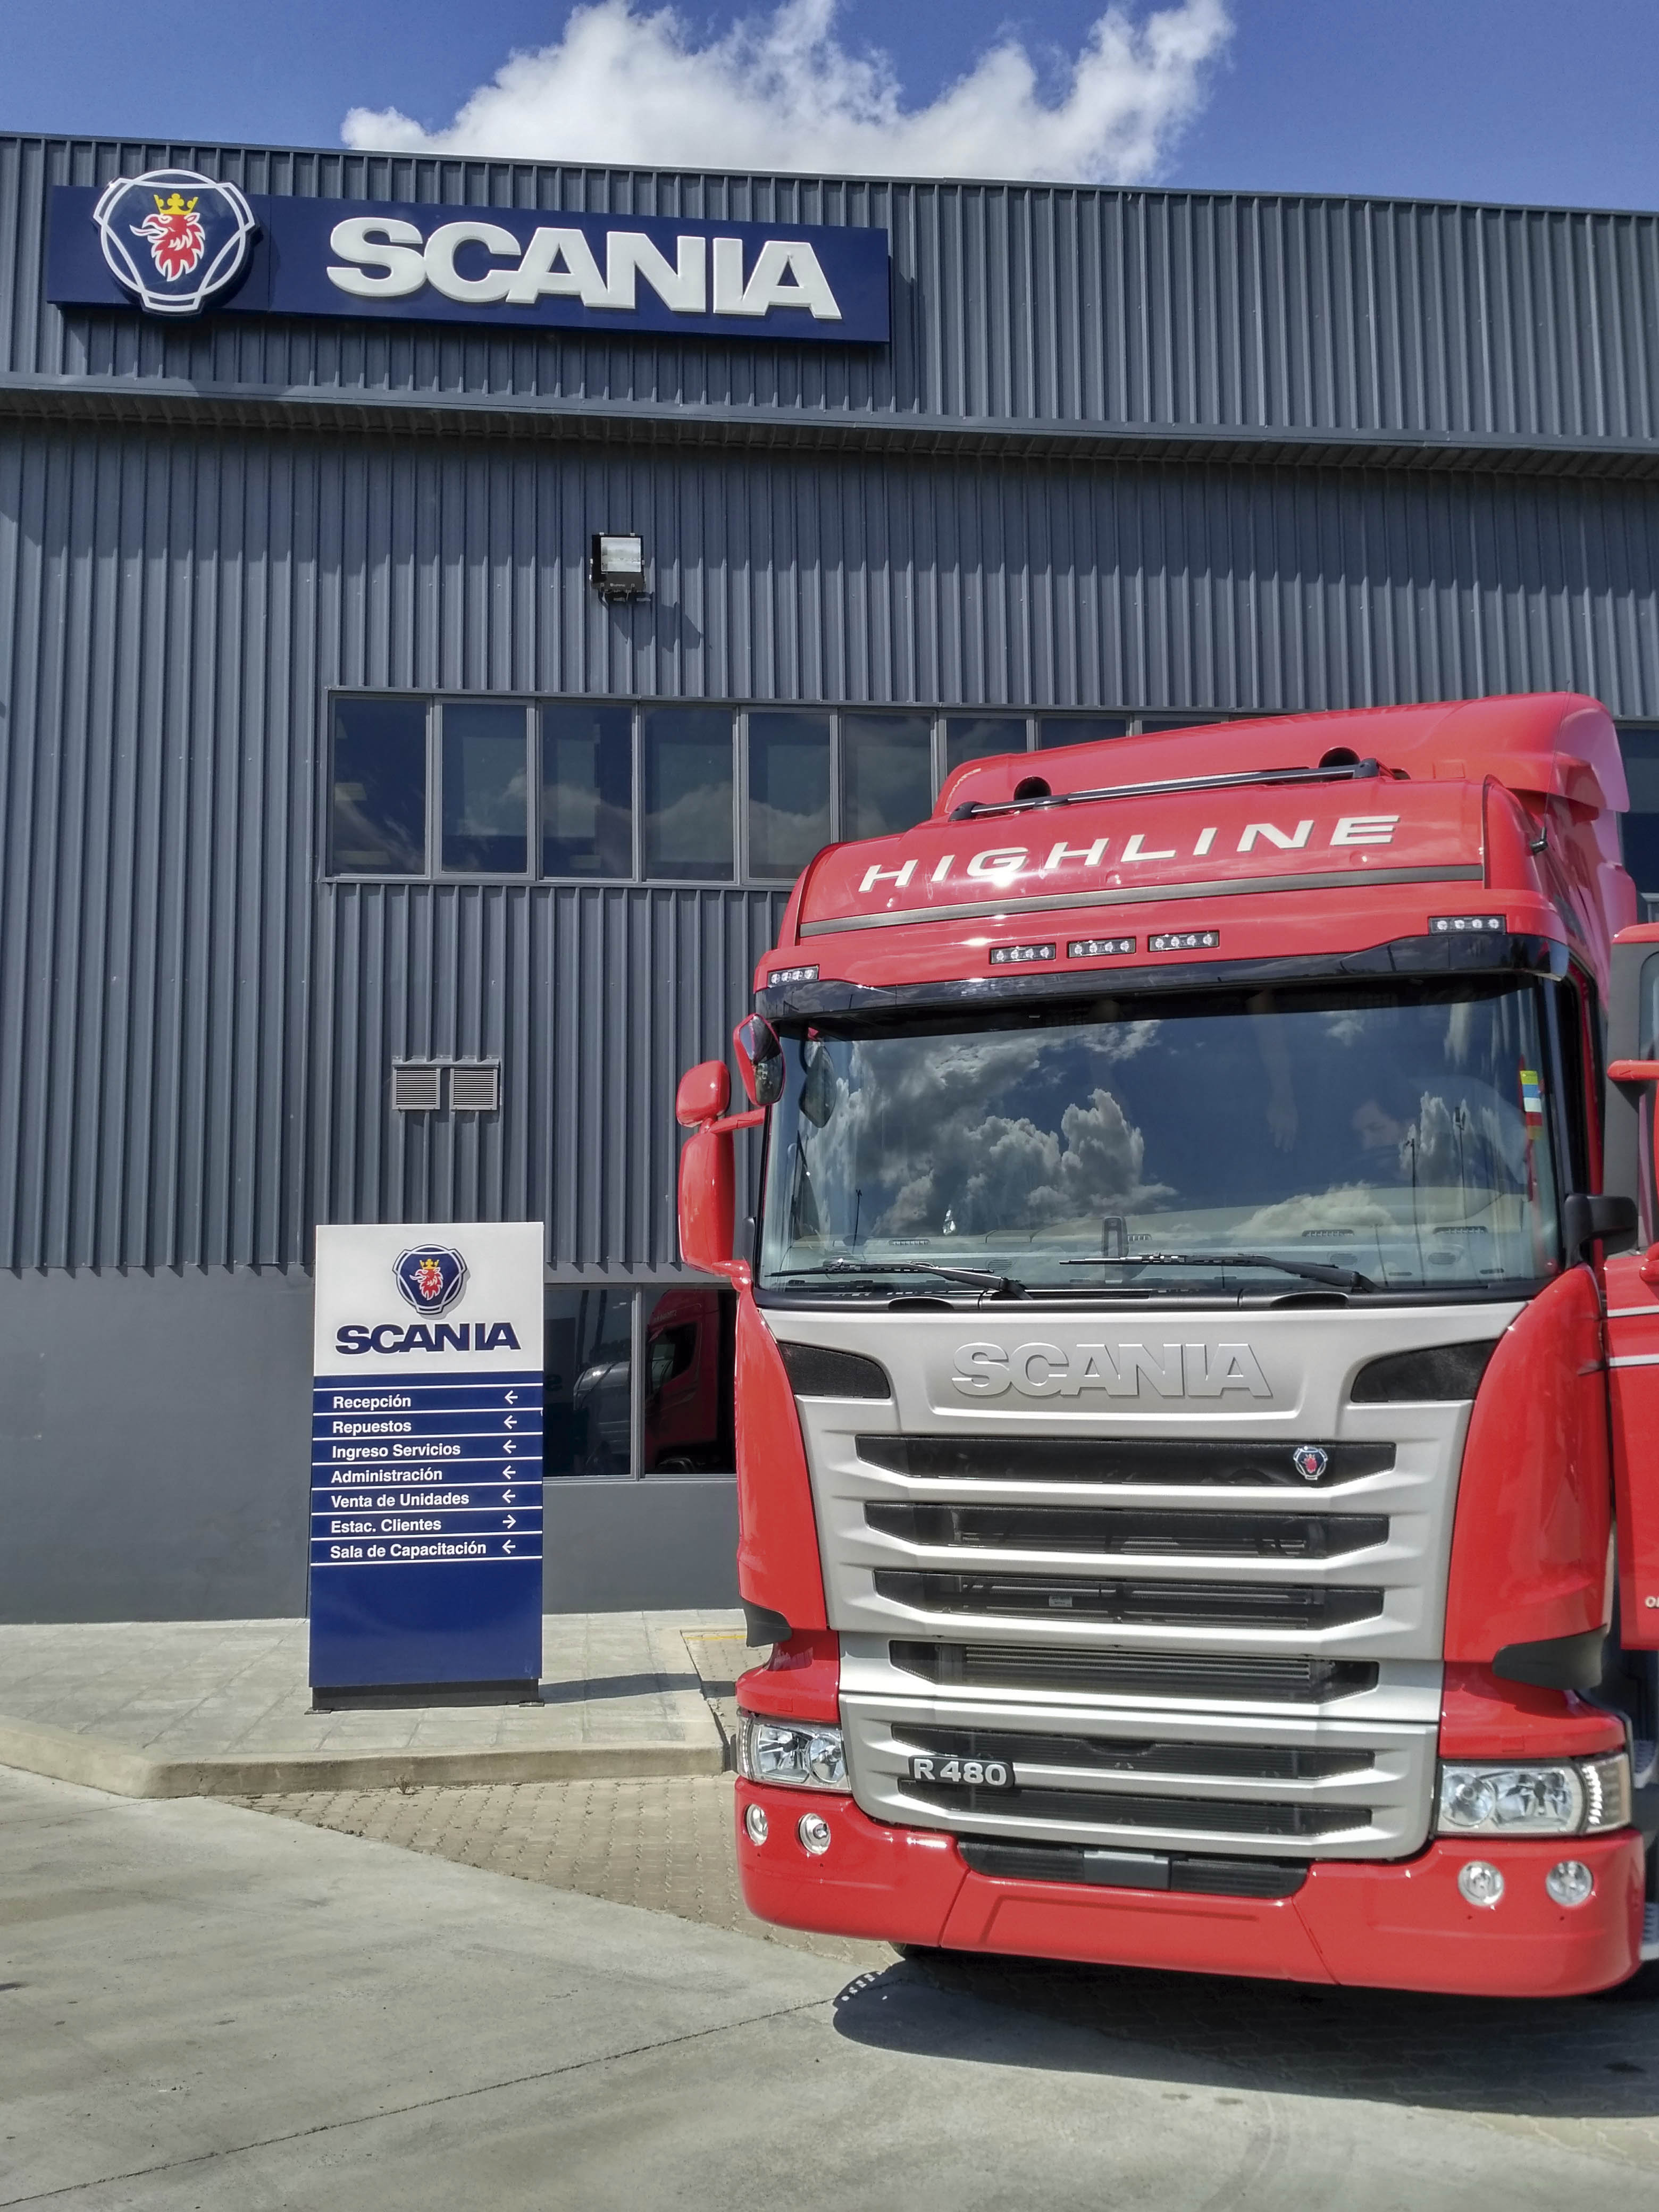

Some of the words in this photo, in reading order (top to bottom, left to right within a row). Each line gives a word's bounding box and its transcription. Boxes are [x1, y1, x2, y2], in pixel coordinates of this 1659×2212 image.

[326, 216, 842, 319] SCANIA
[858, 815, 1400, 893] HIGHLINE
[335, 1322, 522, 1355] SCANIA
[952, 1342, 1273, 1397] SCANIA
[333, 1394, 412, 1411] Recepción
[333, 1420, 412, 1436] Repuestos
[332, 1445, 389, 1461] Ingreso
[392, 1443, 461, 1457] Servicios
[331, 1467, 443, 1483] Administración
[331, 1495, 373, 1508] Venta
[376, 1494, 396, 1507] de
[400, 1492, 470, 1506] Unidades
[331, 1520, 376, 1534] Estac.
[381, 1519, 442, 1532] Clientes
[330, 1545, 363, 1559] Sala
[367, 1544, 386, 1557] de
[390, 1541, 487, 1559] Capacitación
[914, 1758, 935, 1780] R
[940, 1761, 1007, 1786] 480
